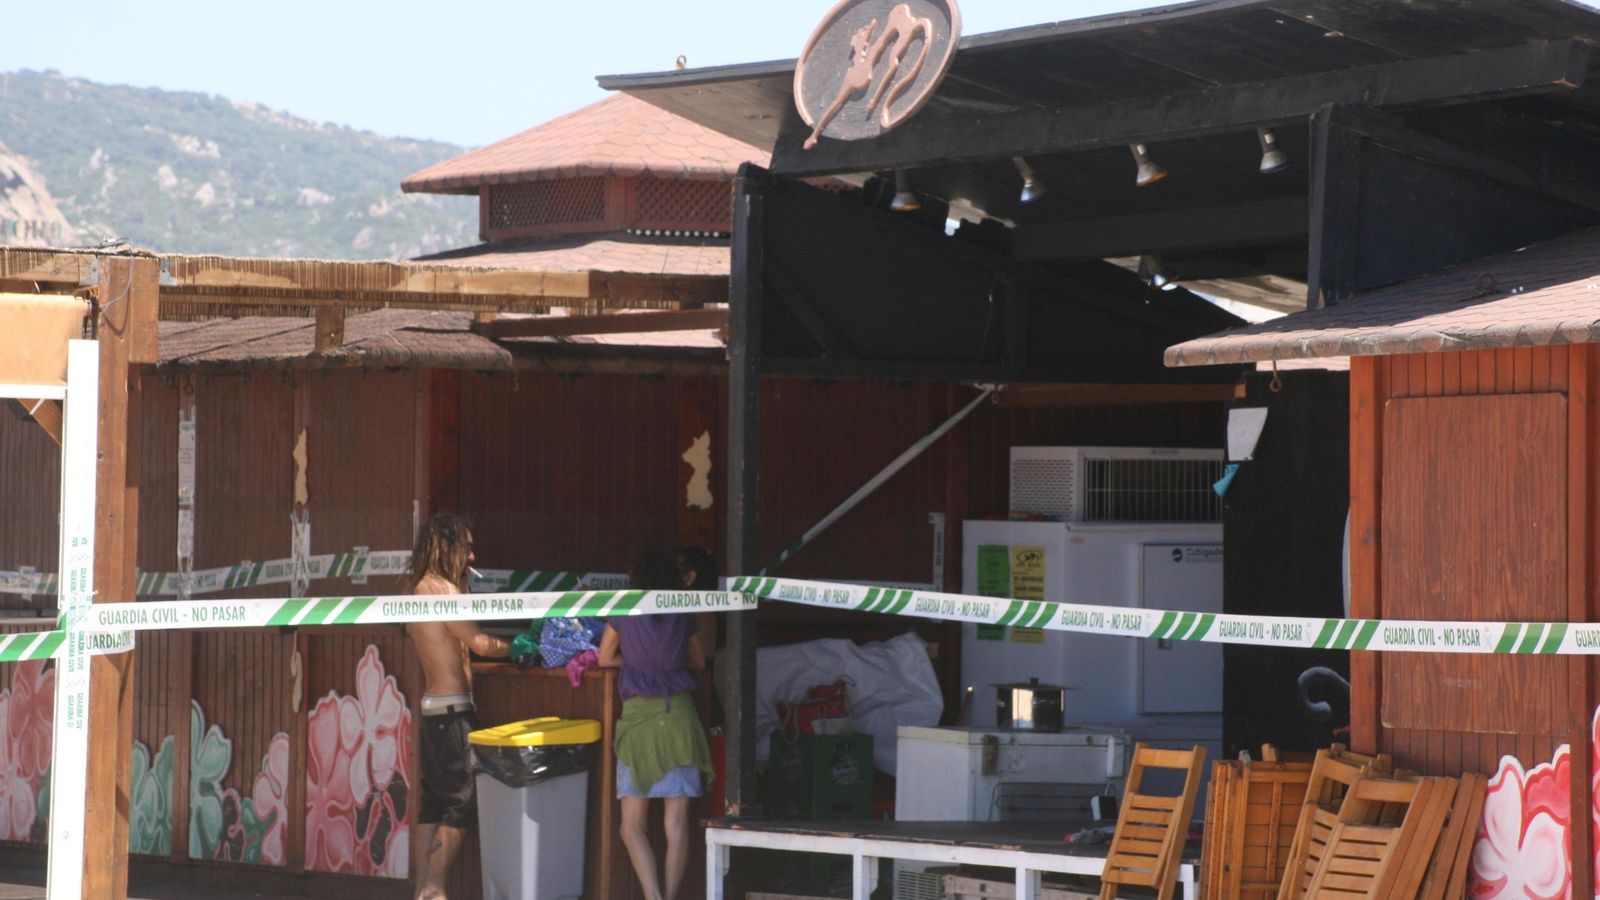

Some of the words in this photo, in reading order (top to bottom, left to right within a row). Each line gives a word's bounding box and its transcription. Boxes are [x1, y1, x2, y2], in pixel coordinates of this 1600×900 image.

[656, 593, 701, 609] GUARDIA
[705, 592, 730, 607] CIVIL
[779, 583, 801, 600] GUARDIA
[803, 586, 817, 602] CIVIL
[823, 587, 832, 602] NO
[833, 589, 850, 604] PASAR
[98, 608, 148, 626] GUARDIA
[152, 606, 179, 624] CIVIL
[192, 606, 208, 621] NO
[212, 605, 246, 621] PASAR
[383, 601, 429, 617] GUARDIA
[433, 600, 459, 616] CIVIL
[472, 599, 487, 614] NO
[491, 598, 523, 613] PASAR
[915, 597, 939, 614] GUARDIA
[941, 600, 956, 615] CIVIL
[961, 602, 970, 616] NO
[972, 602, 990, 617] PASAR
[1061, 610, 1087, 626] GUARDIA
[1089, 613, 1103, 628] CIVIL
[1111, 613, 1121, 629] NO
[1122, 614, 1141, 631] PASAR
[86, 632, 121, 649] UARDIA
[1219, 622, 1247, 638] GUARDIA
[1249, 622, 1264, 639] CIVIL
[1271, 623, 1281, 640] NO
[1282, 624, 1302, 641] PASAR
[1383, 628, 1415, 646] GUARDIA
[1418, 628, 1436, 646] CIVIL
[1443, 629, 1455, 646] NO
[1457, 629, 1480, 647] PASAR
